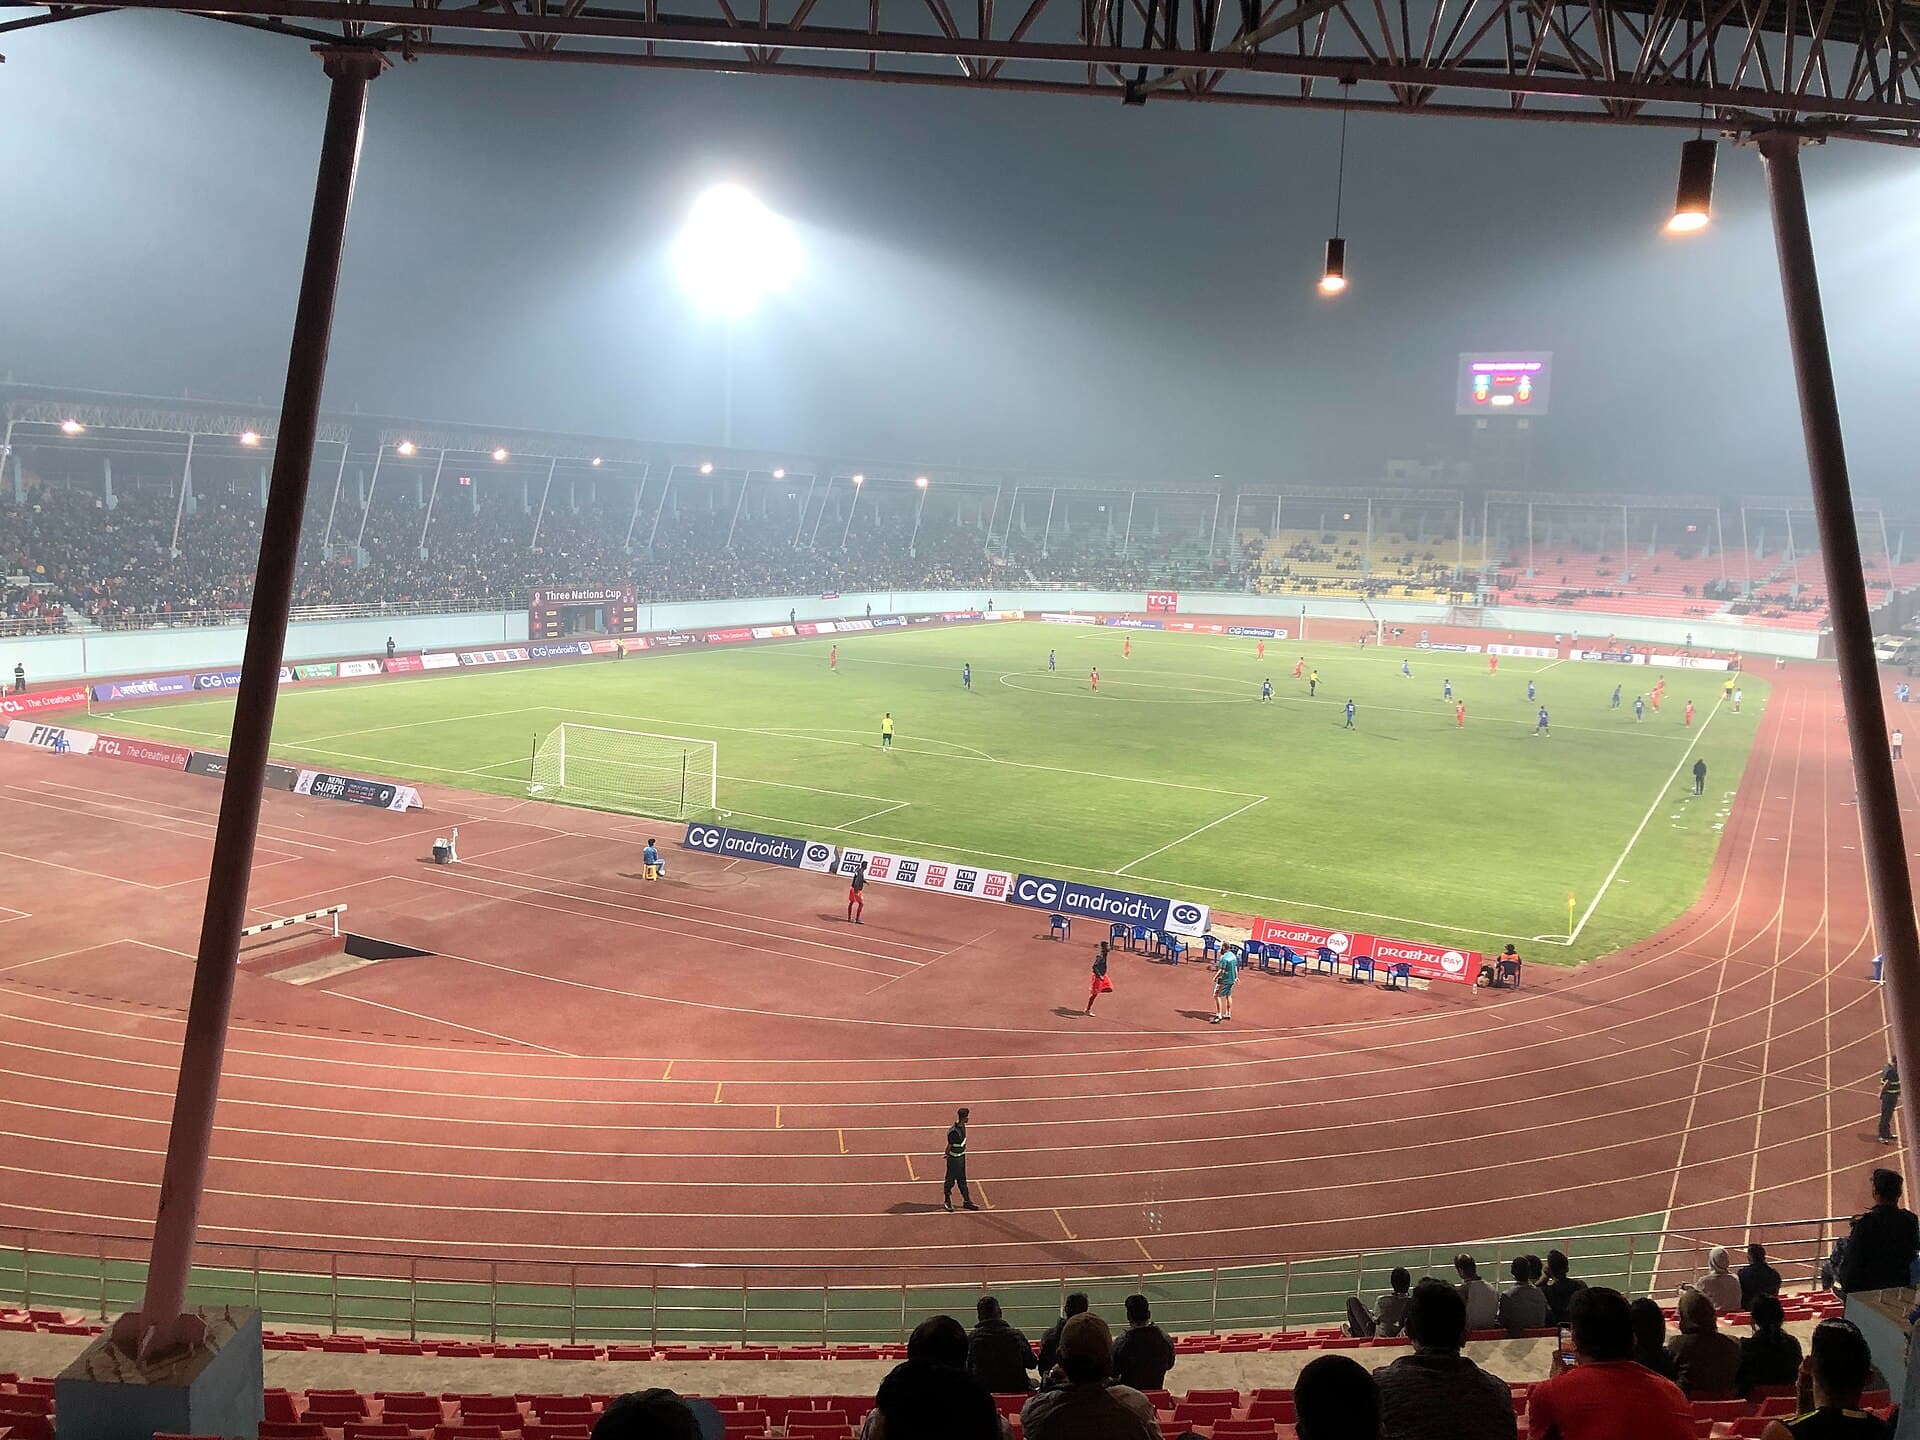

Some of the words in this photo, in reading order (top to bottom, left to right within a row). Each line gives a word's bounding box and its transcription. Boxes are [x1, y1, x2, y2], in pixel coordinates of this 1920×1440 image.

[545, 591, 569, 600] Three
[572, 590, 603, 600] Nations
[606, 589, 621, 599] Cup
[1149, 595, 1176, 605] TCL
[1228, 627, 1241, 635] CG
[708, 633, 720, 641] TCL
[532, 647, 546, 657] CG
[201, 676, 221, 688] CG
[27, 699, 42, 707] The
[42, 695, 72, 706] Creative
[72, 692, 86, 701] Life
[29, 726, 65, 747] FIFA
[98, 740, 121, 755] TCL
[127, 746, 140, 757] The
[140, 748, 170, 762] Creative
[171, 753, 185, 765] Life
[327, 776, 346, 786] NEPAL
[314, 782, 346, 796] SUPER
[689, 827, 720, 848] CG
[725, 836, 799, 860] androidtv
[809, 847, 827, 859] CG
[846, 853, 862, 862] KTM
[873, 857, 889, 866] KTM
[843, 863, 860, 873] CTY
[901, 862, 918, 871] KTM
[929, 866, 946, 875] KTM
[870, 868, 886, 877] CTY
[898, 872, 914, 881] CTY
[959, 870, 976, 880] KTM
[927, 877, 944, 886] CTY
[988, 875, 1005, 885] KTM
[956, 882, 973, 891] CTY
[985, 887, 1002, 896] CTY
[1018, 880, 1057, 904] CG
[1066, 893, 1162, 921] androidtv
[1175, 908, 1198, 921] CG
[1329, 938, 1346, 947] PAY
[1443, 957, 1462, 966] PAY
